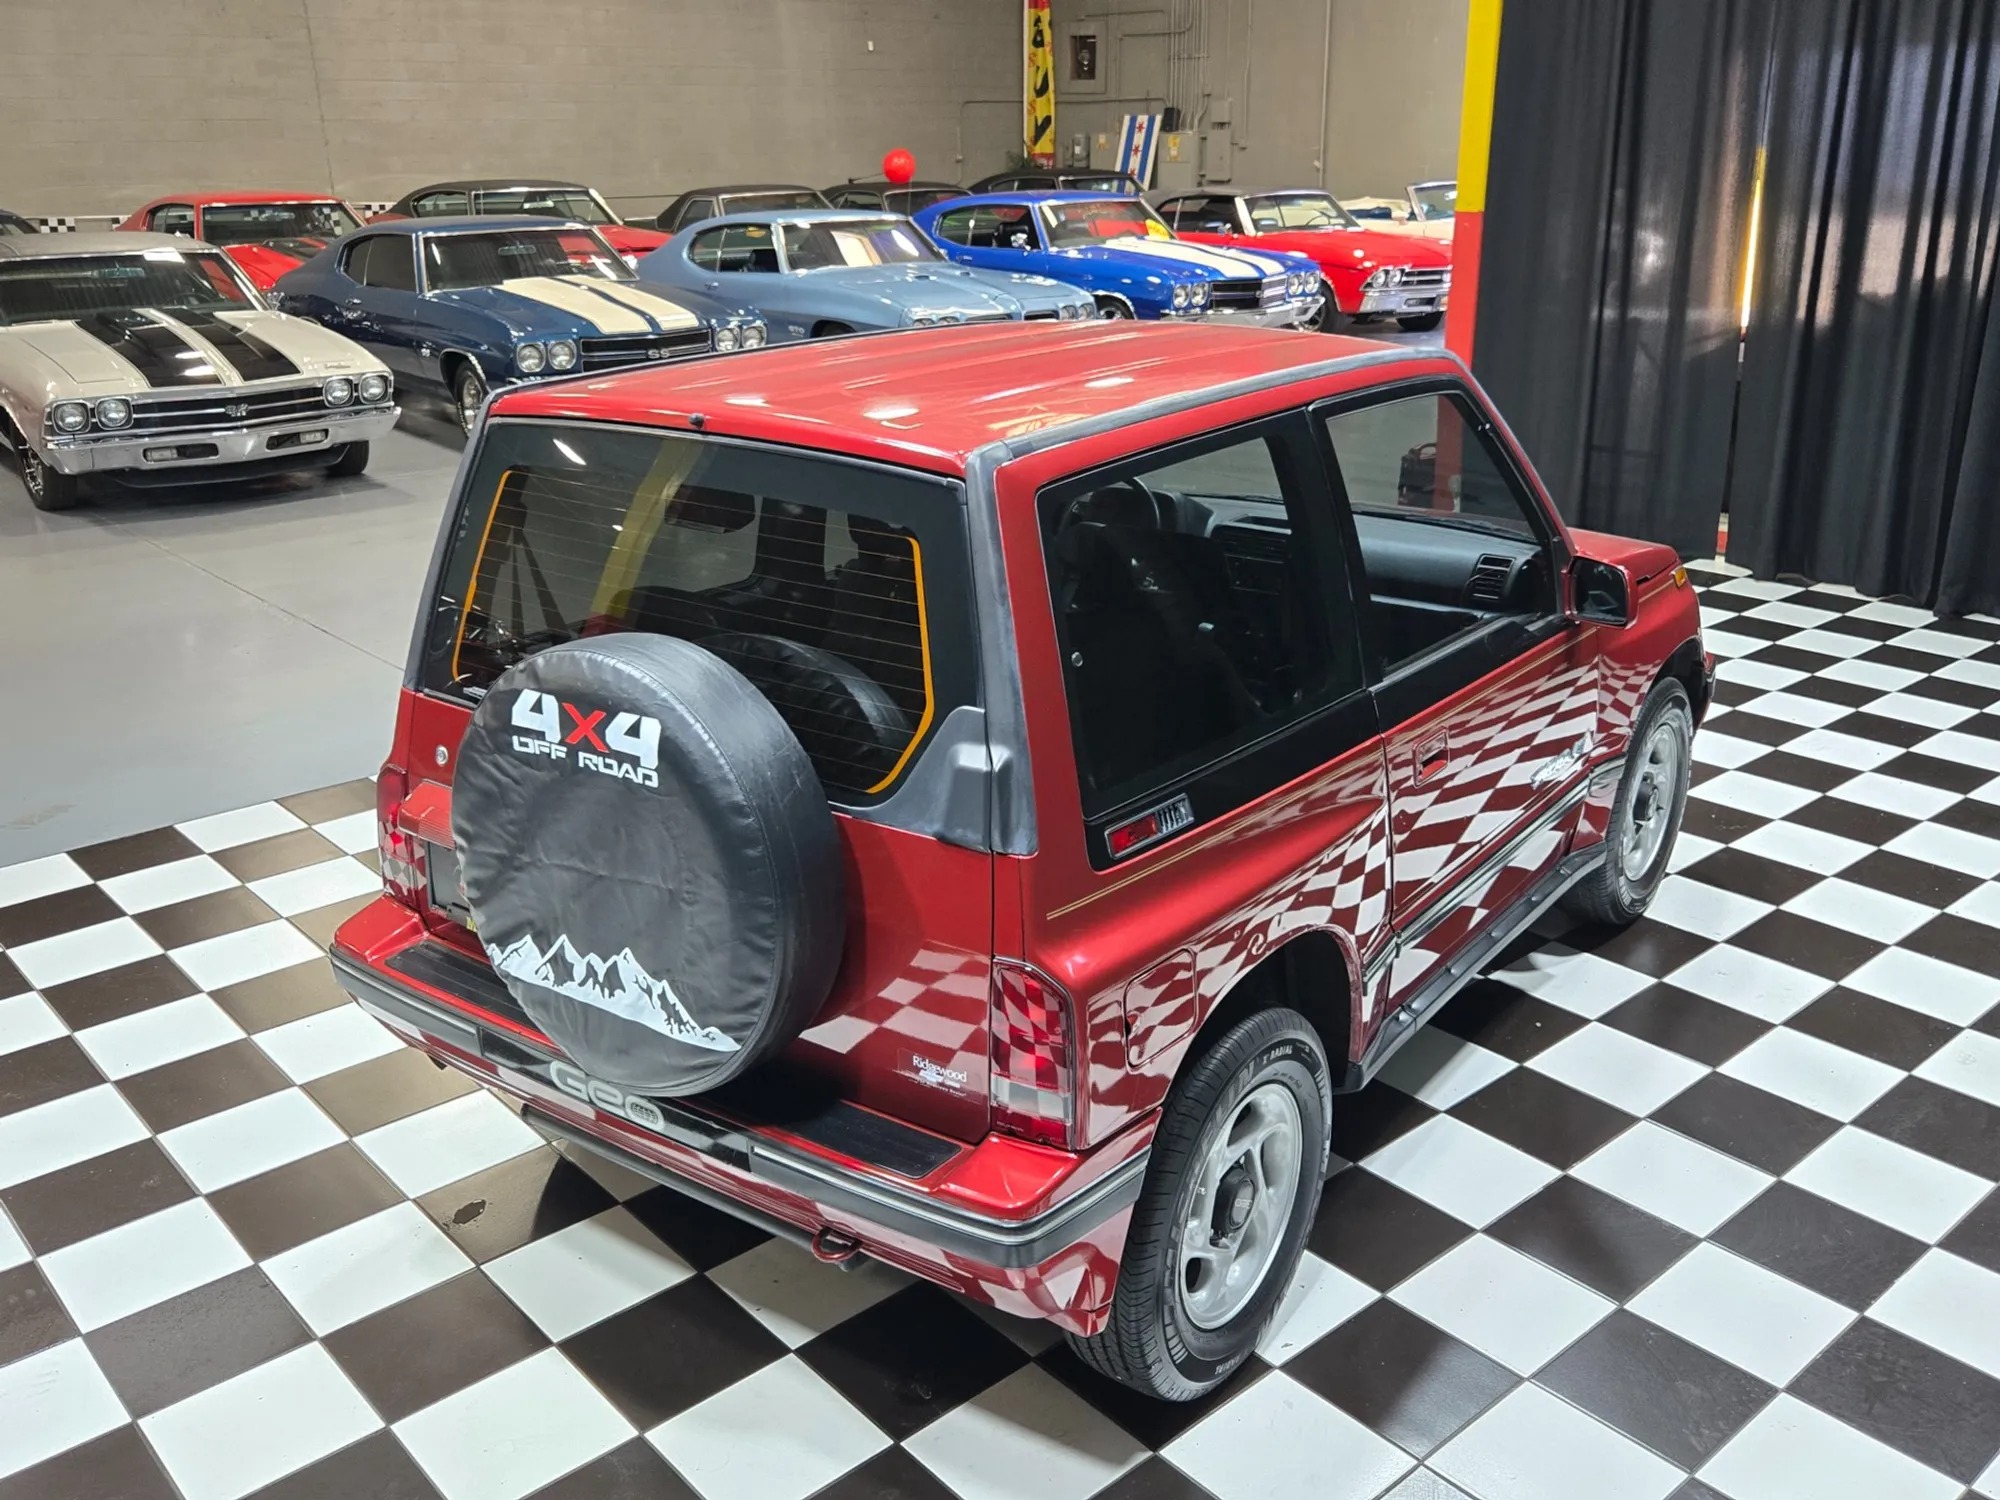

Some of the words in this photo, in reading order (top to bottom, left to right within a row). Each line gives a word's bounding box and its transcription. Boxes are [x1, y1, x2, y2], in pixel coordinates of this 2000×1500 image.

[647, 348, 670, 359] SS
[511, 735, 568, 760] OFF
[577, 751, 660, 789] ROAD
[912, 1055, 968, 1083] Ridgewood
